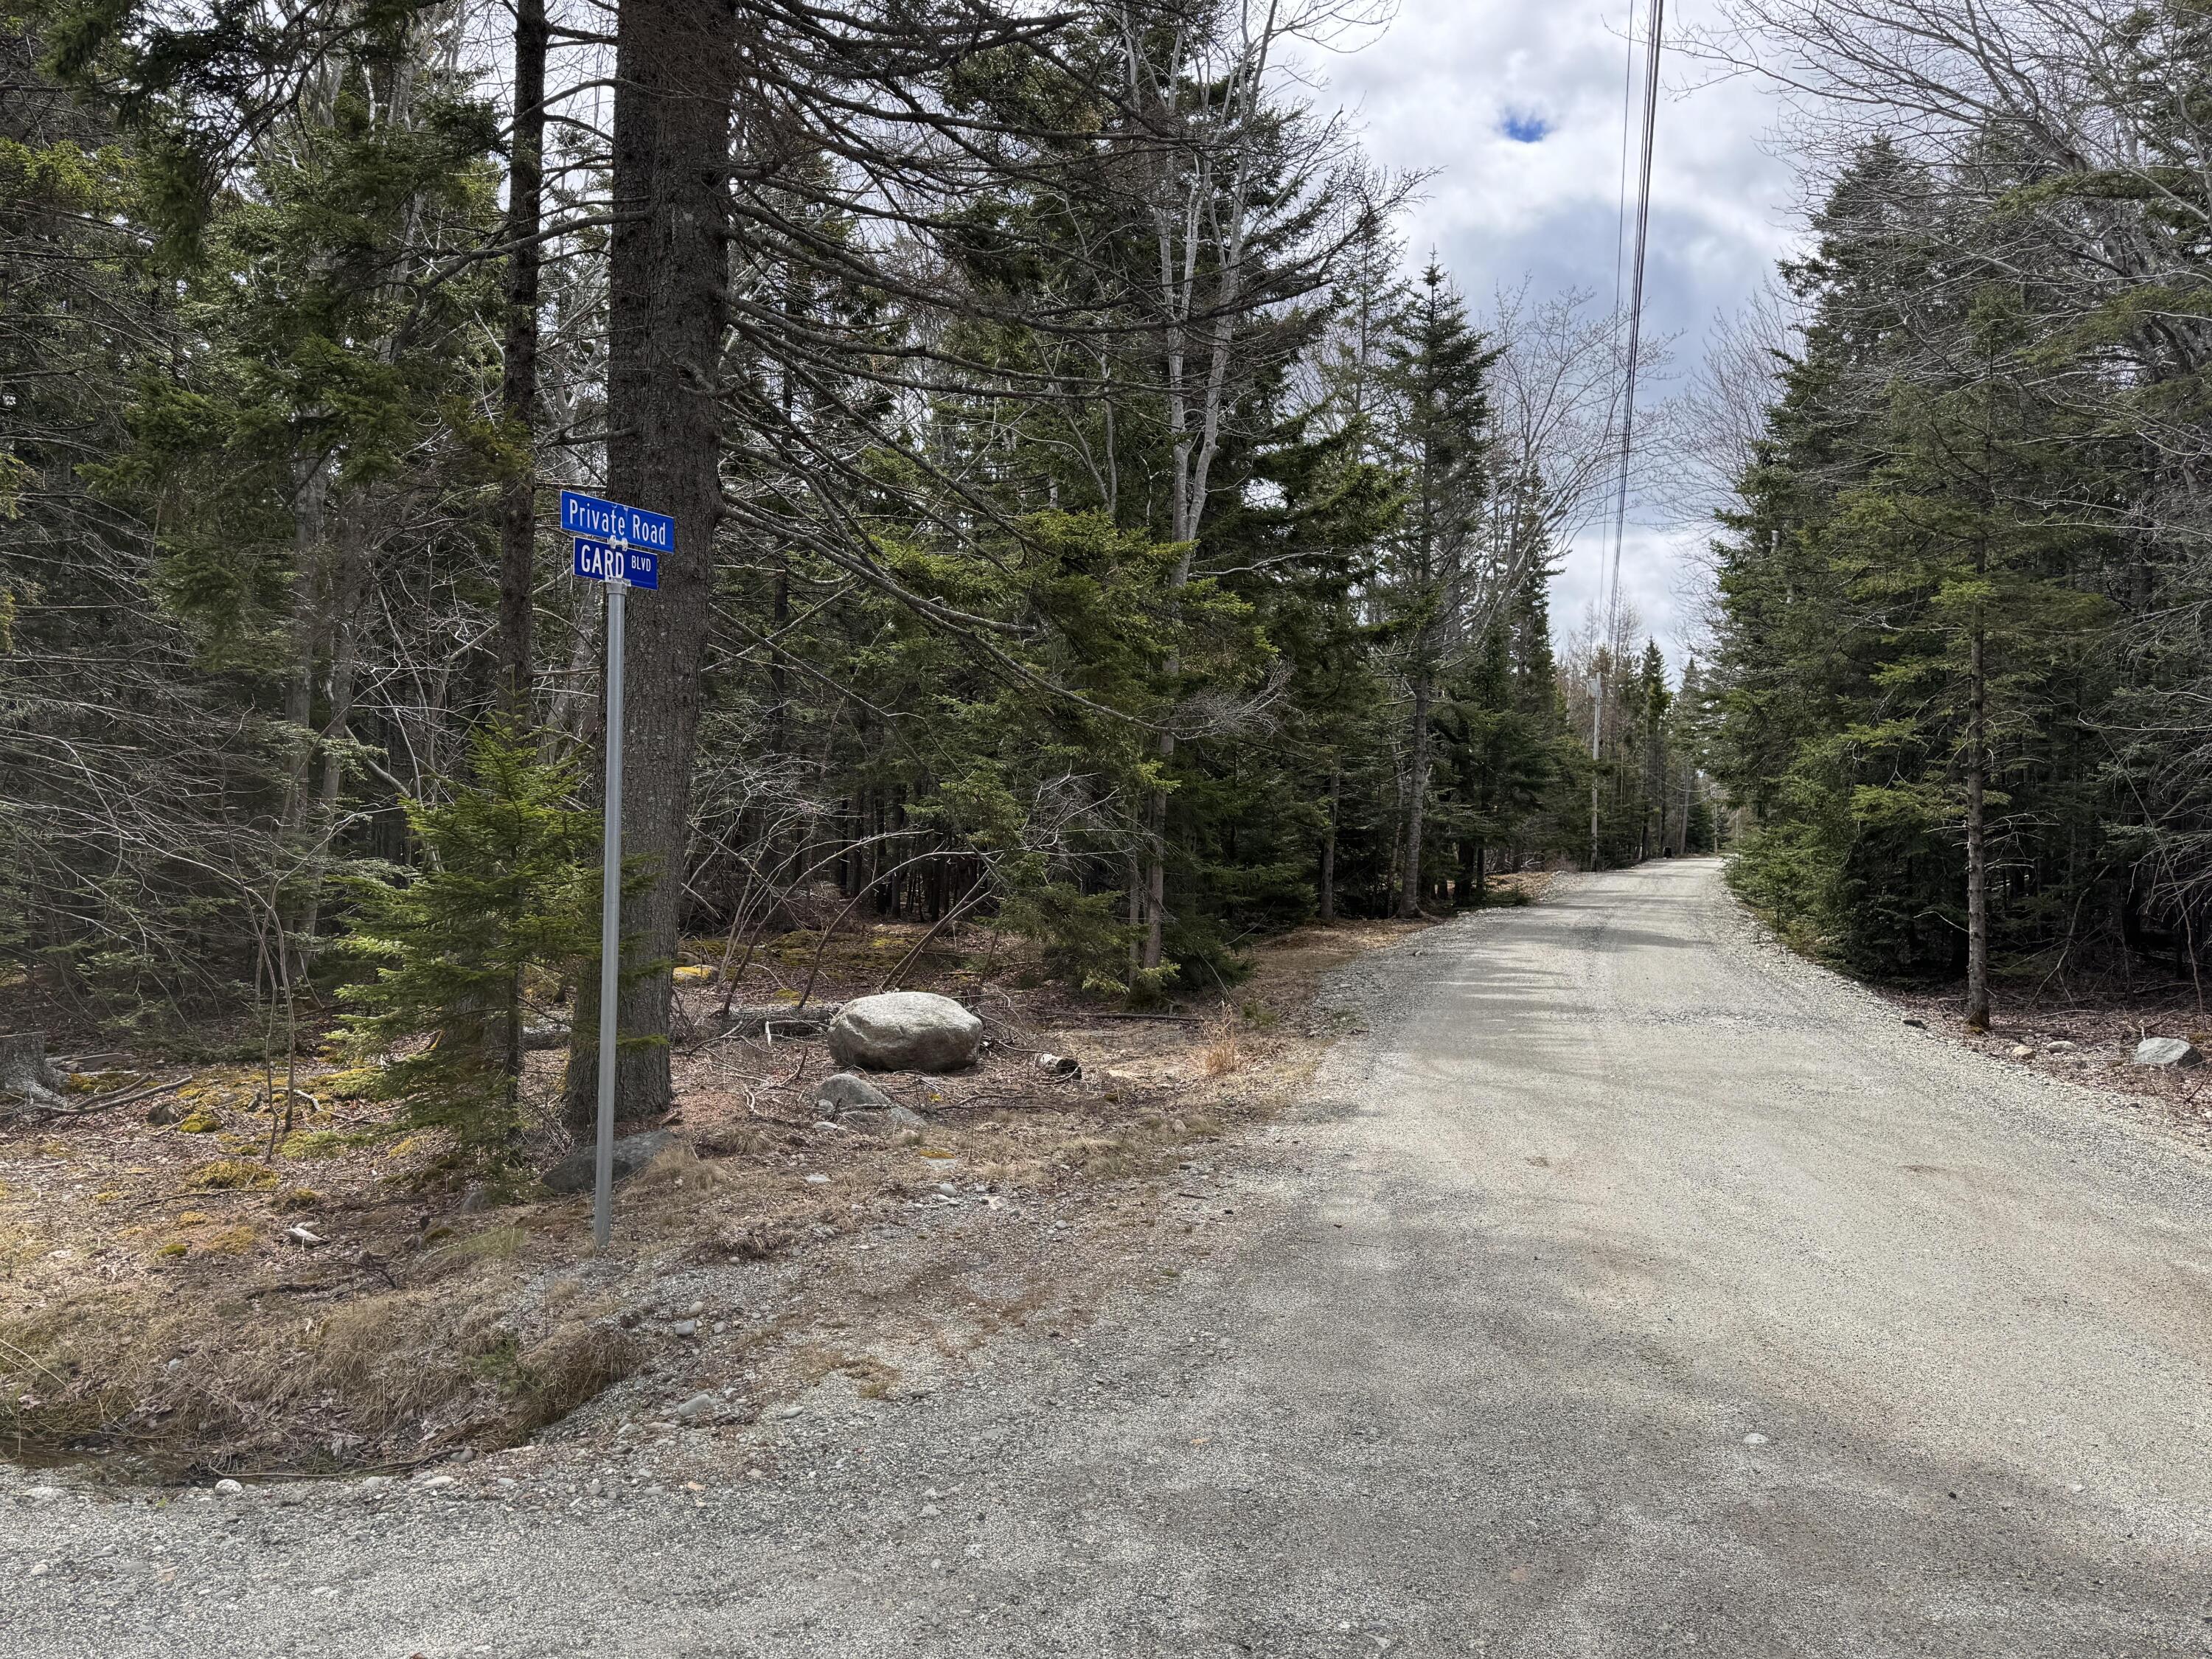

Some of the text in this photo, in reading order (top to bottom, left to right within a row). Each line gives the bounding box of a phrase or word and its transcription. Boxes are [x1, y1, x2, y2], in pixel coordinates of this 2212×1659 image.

[569, 498, 666, 546] Private Road
[581, 544, 651, 579] GARD BLVD
